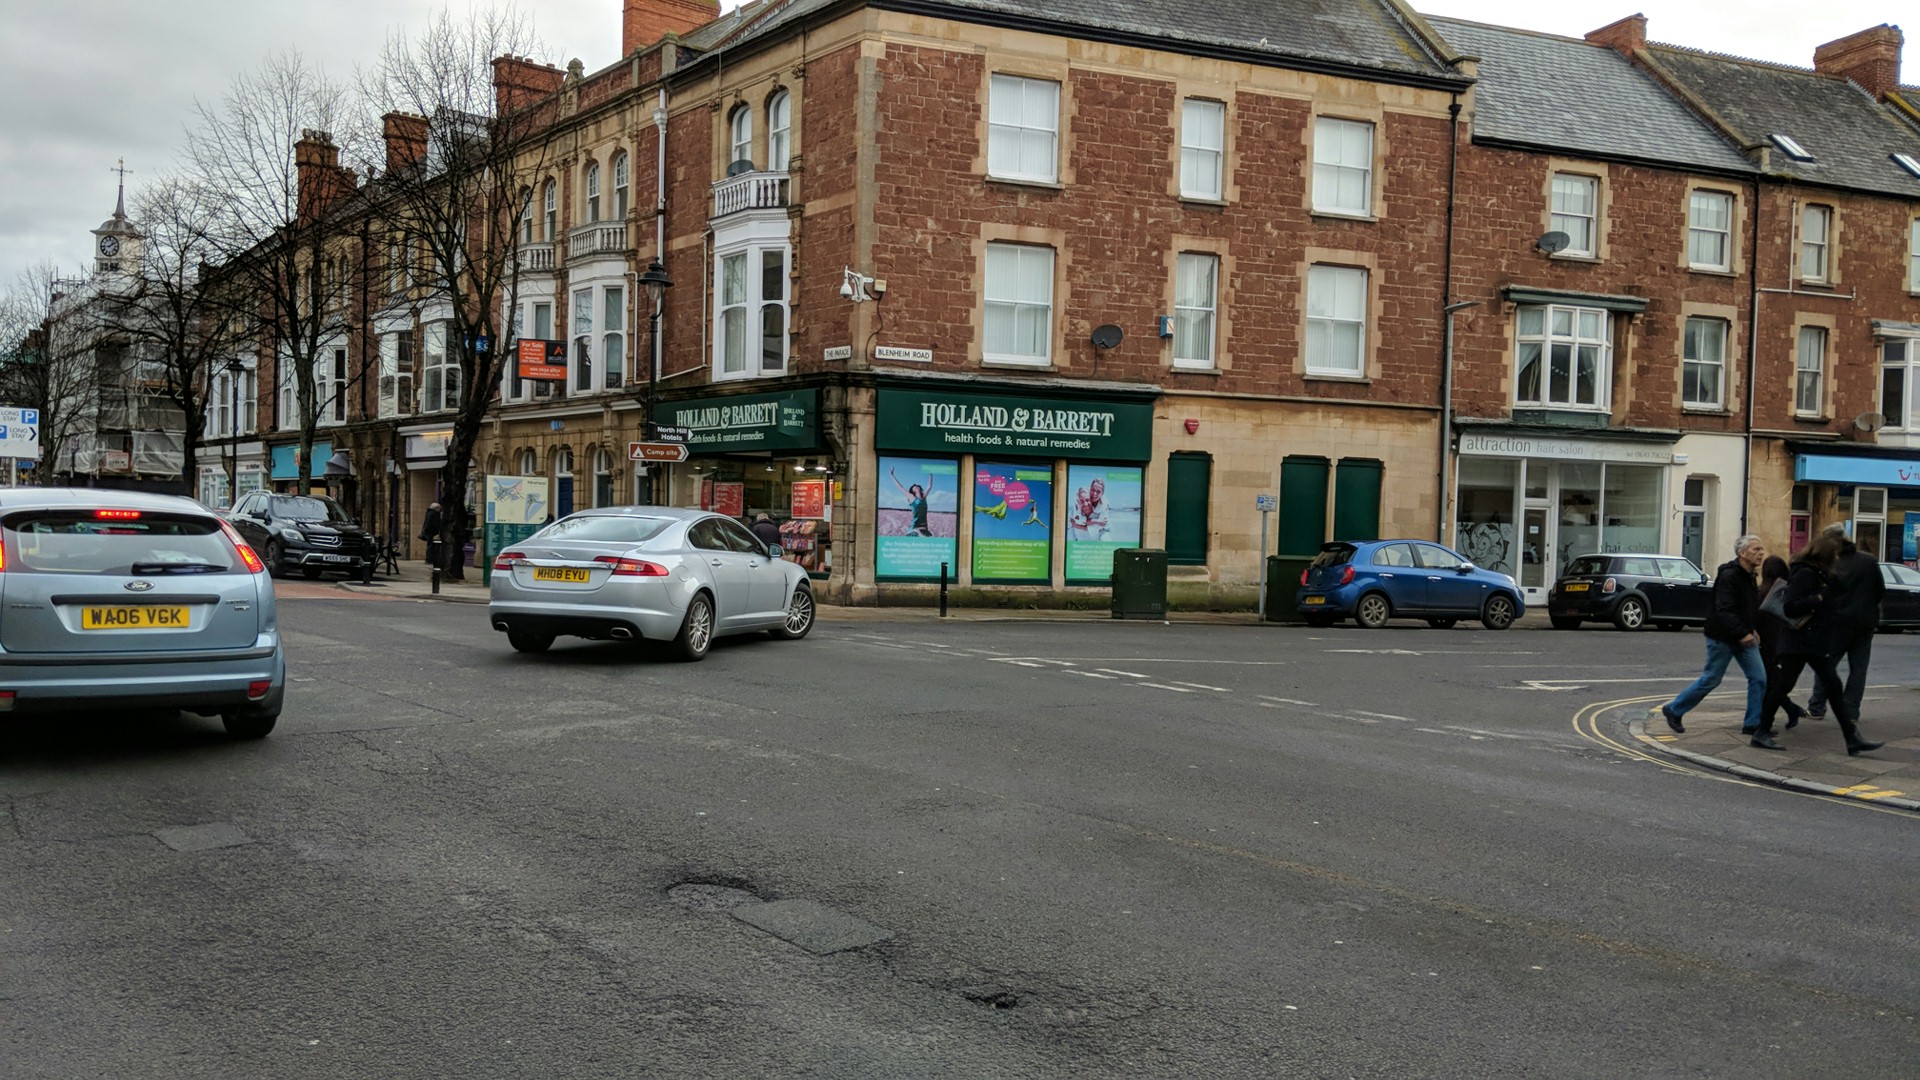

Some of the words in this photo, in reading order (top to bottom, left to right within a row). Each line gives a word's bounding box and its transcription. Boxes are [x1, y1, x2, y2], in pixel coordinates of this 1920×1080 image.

[826, 350, 834, 358] THE
[835, 348, 849, 357] PARADE
[877, 348, 911, 358] BLENHEIM
[912, 350, 930, 359] ROAD
[676, 407, 720, 427] HOLLAND
[720, 406, 732, 429] &
[732, 402, 779, 426] BARRETT
[783, 407, 805, 416] HOLLAND
[783, 419, 804, 428] BARRETT
[920, 402, 1009, 428] HOLLAND
[1011, 407, 1030, 432] &
[1032, 408, 1115, 437] BARRETT
[656, 426, 676, 434] North
[661, 433, 683, 441] Hotels
[723, 432, 741, 442] natural
[741, 431, 764, 441] remedies
[944, 432, 974, 444] health
[976, 433, 1002, 445] foods
[1005, 435, 1013, 446] &
[1016, 437, 1048, 448] natural
[1050, 438, 1091, 449] remedies
[1466, 436, 1531, 453] attraction
[1536, 440, 1554, 454] hair
[1559, 442, 1584, 456] salon
[646, 448, 665, 456] Camp
[1605, 542, 1625, 553] hai
[537, 568, 563, 579] MH08
[565, 570, 586, 580] EYU
[91, 608, 140, 625] WA06
[149, 608, 182, 625] VGK
